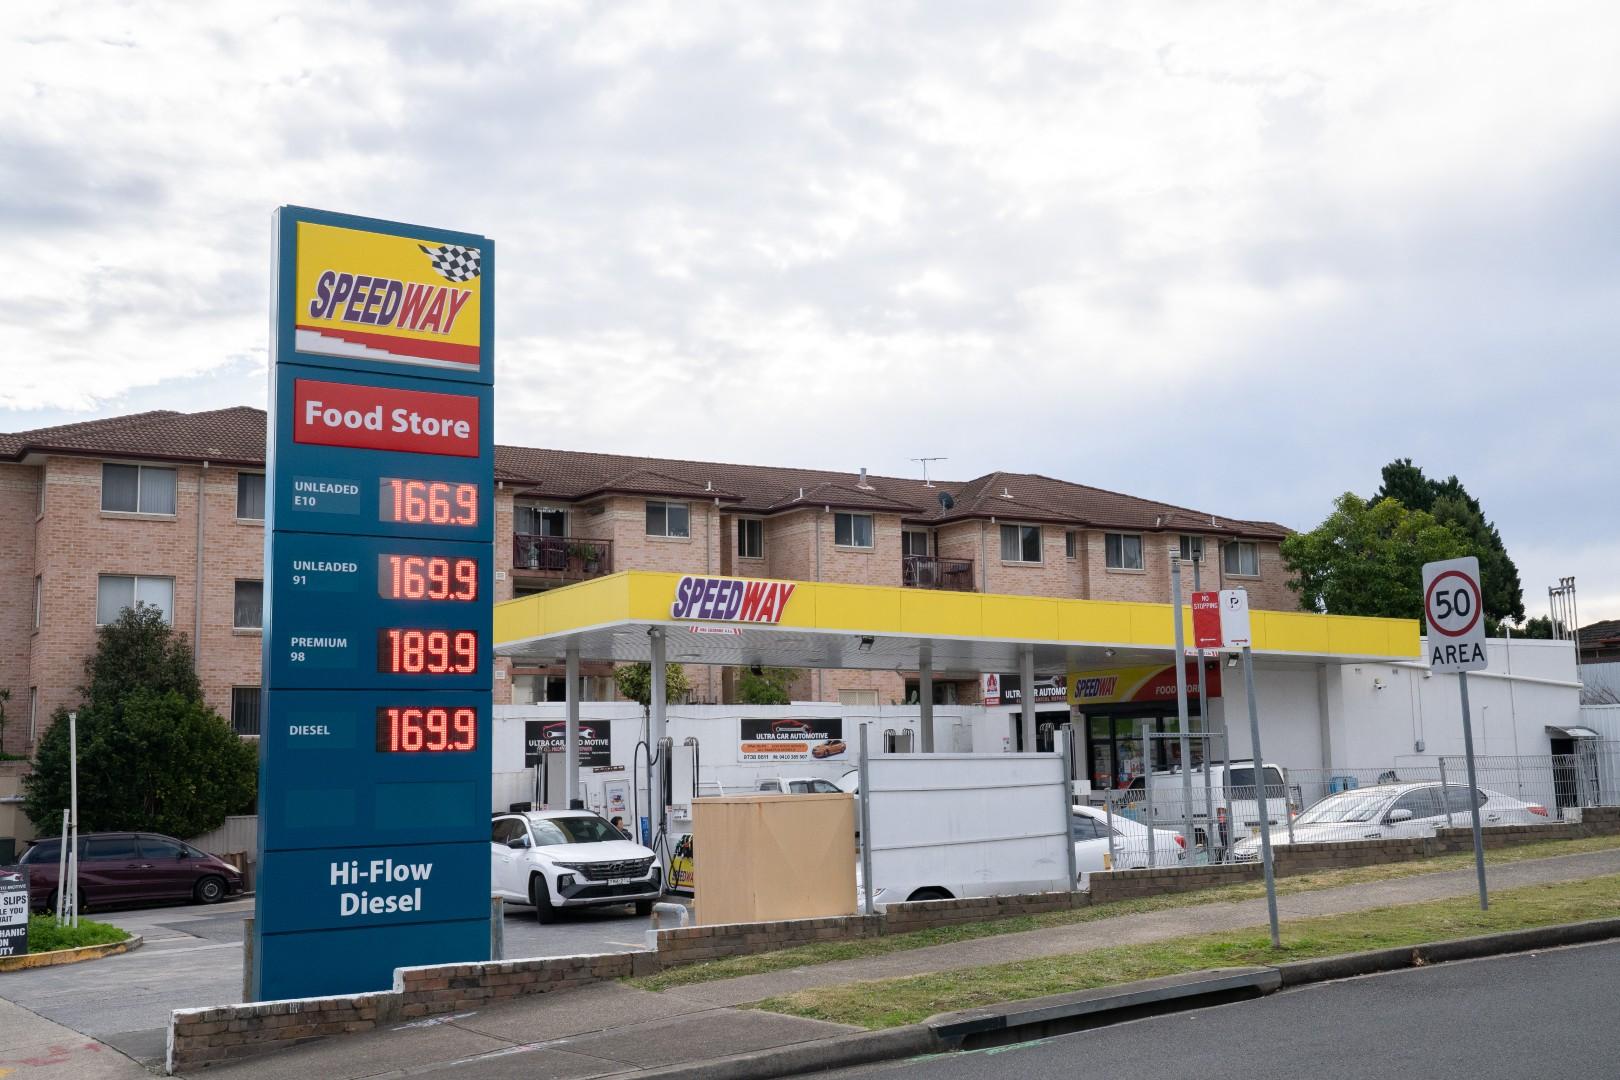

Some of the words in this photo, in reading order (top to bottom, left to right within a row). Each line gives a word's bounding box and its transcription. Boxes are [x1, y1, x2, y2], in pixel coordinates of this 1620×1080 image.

[309, 270, 472, 334] SPEEDWAY
[305, 400, 382, 431] Food
[391, 408, 470, 439] Store
[295, 481, 358, 495] UNLEADED
[294, 495, 316, 506] E10
[390, 479, 477, 525] 166.9
[293, 560, 357, 573] UNLEADED
[292, 575, 306, 585] 91
[390, 556, 477, 600] 169.9
[673, 576, 795, 622] SPEEDWAY
[1193, 602, 1218, 610] STOPPING
[1435, 588, 1470, 619] 50
[291, 637, 347, 648] PREMIUM
[290, 652, 305, 662] 98
[389, 630, 476, 673] 189.9
[1432, 642, 1485, 665] AREA
[1074, 677, 1117, 698] SPEEDWAY
[1155, 685, 1176, 695] FOOD
[289, 725, 330, 736] DIESEL
[387, 709, 475, 751] 169.9
[330, 858, 433, 886] Hi-Flow
[3, 895, 27, 906] SLIPS
[340, 887, 421, 917] Diesel
[0, 915, 12, 923] AIT
[10, 907, 23, 915] YOU
